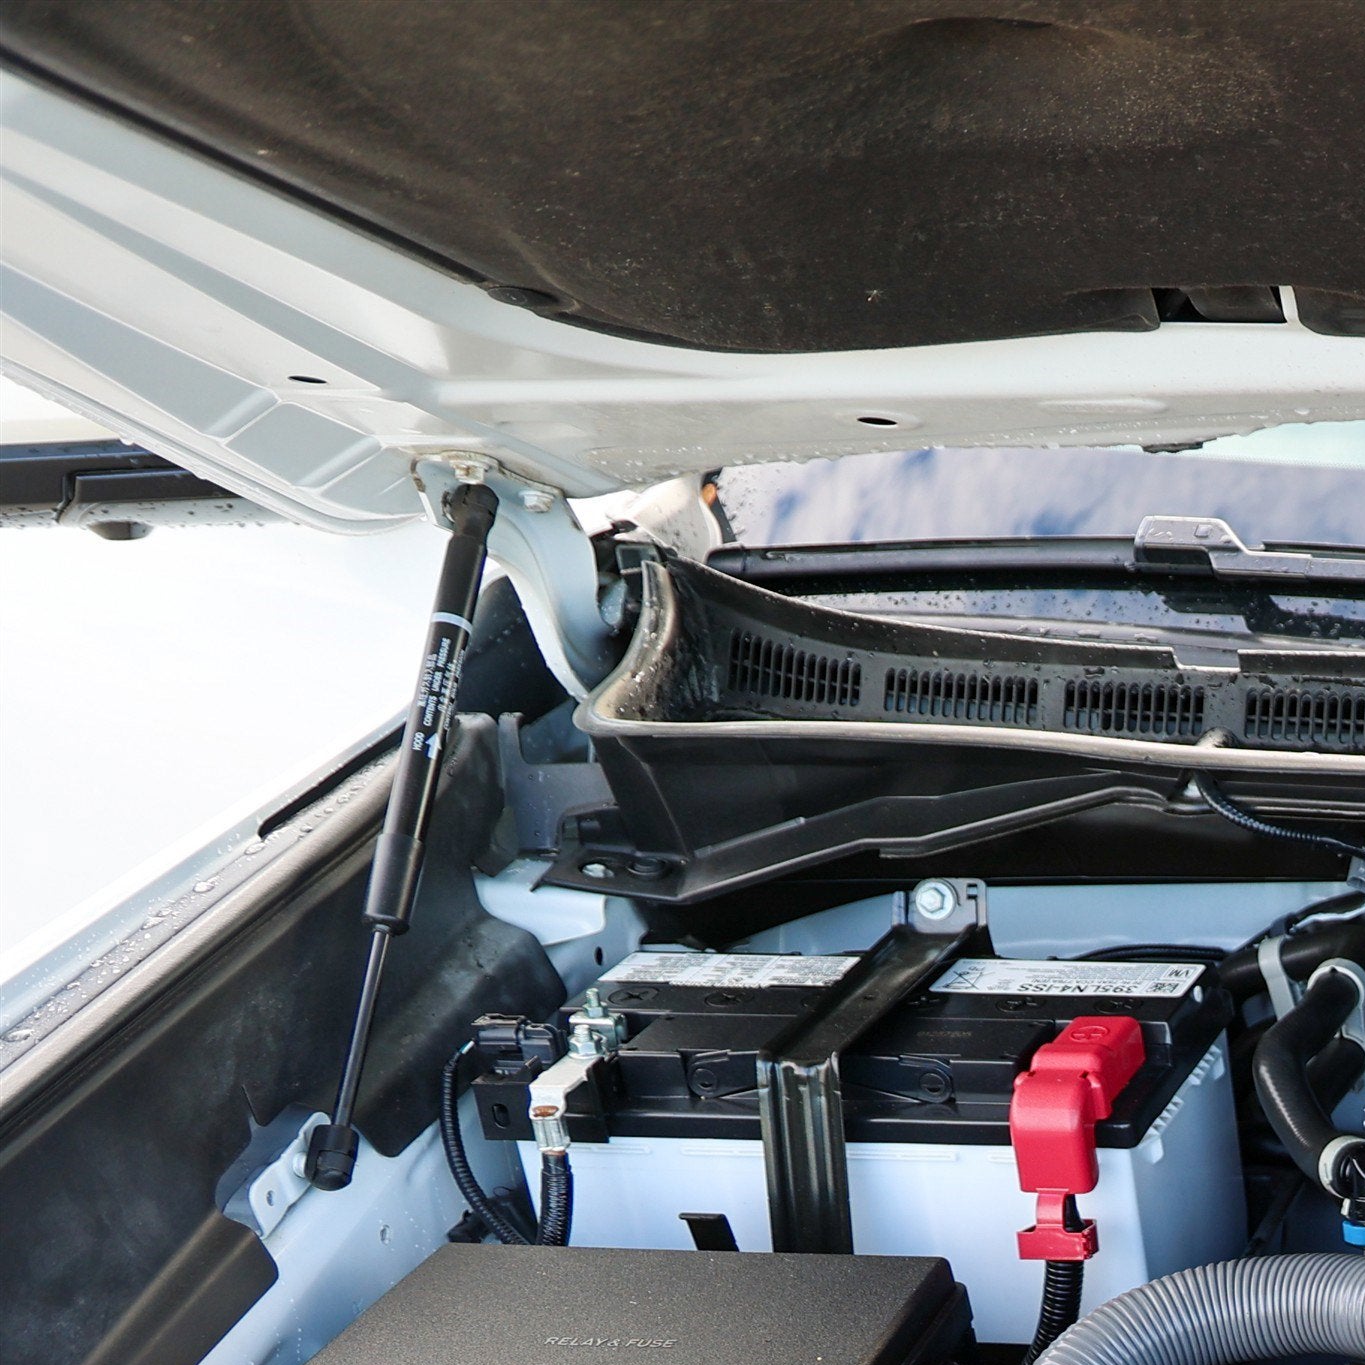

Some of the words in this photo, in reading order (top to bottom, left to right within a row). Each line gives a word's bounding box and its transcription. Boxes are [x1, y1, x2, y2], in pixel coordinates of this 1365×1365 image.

[437, 637, 451, 667] PRESSURE
[432, 671, 443, 692] UNDER
[423, 695, 438, 726] CONTENTS
[412, 732, 426, 751] HOOD
[1017, 983, 1139, 994] 395LN4-ISS
[624, 1339, 678, 1348] FUSE
